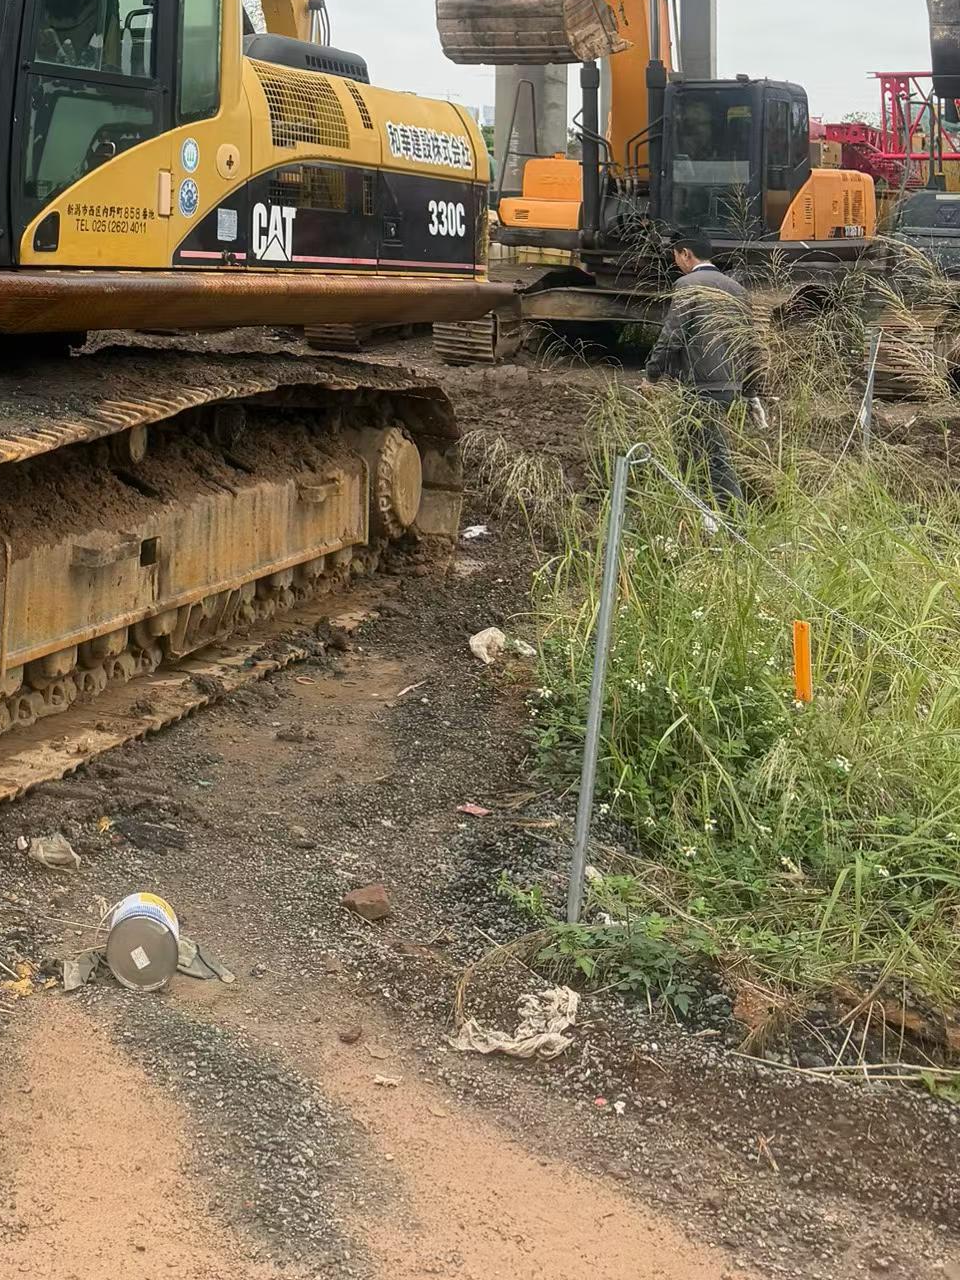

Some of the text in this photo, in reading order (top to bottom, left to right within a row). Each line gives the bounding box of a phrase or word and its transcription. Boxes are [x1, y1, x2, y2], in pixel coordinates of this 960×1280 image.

[76, 218, 89, 232] TEL
[252, 202, 297, 262] CAT
[428, 199, 466, 238] 330C
